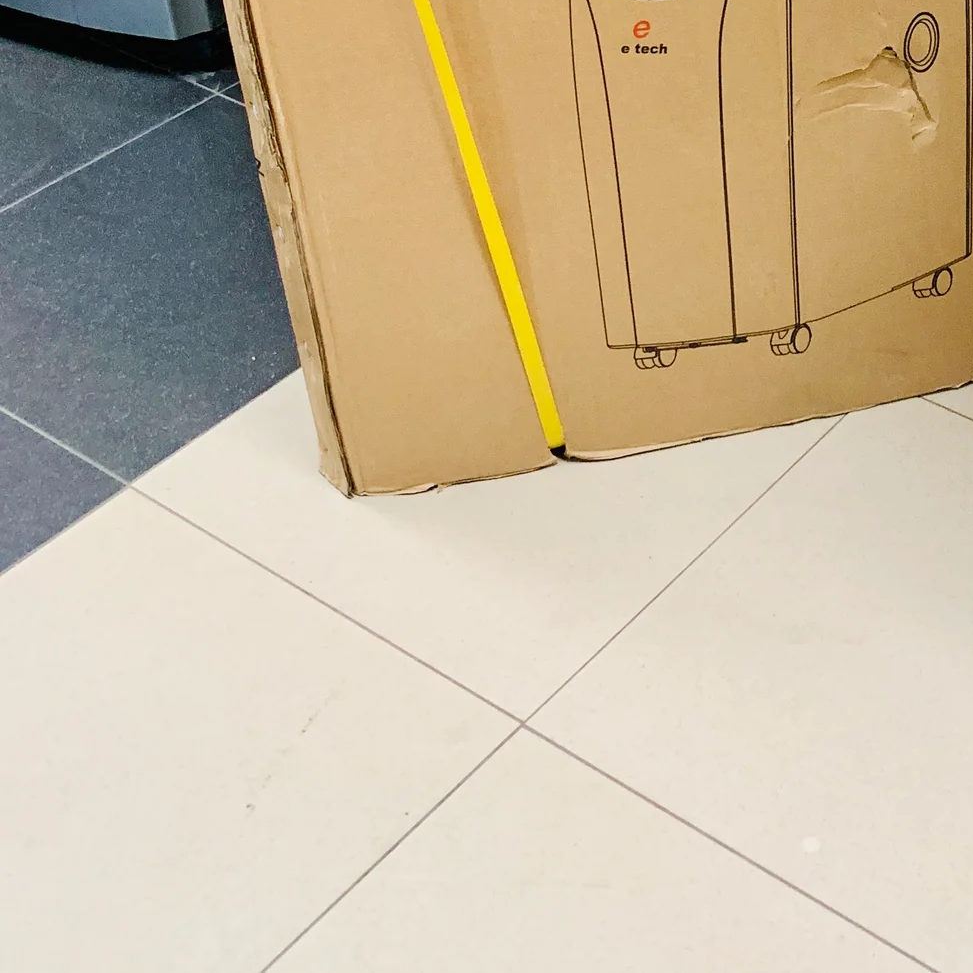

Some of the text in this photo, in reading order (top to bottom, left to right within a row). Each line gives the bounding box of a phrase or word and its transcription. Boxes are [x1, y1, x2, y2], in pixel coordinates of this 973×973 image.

[632, 20, 651, 39] e
[620, 43, 668, 55] e tech
